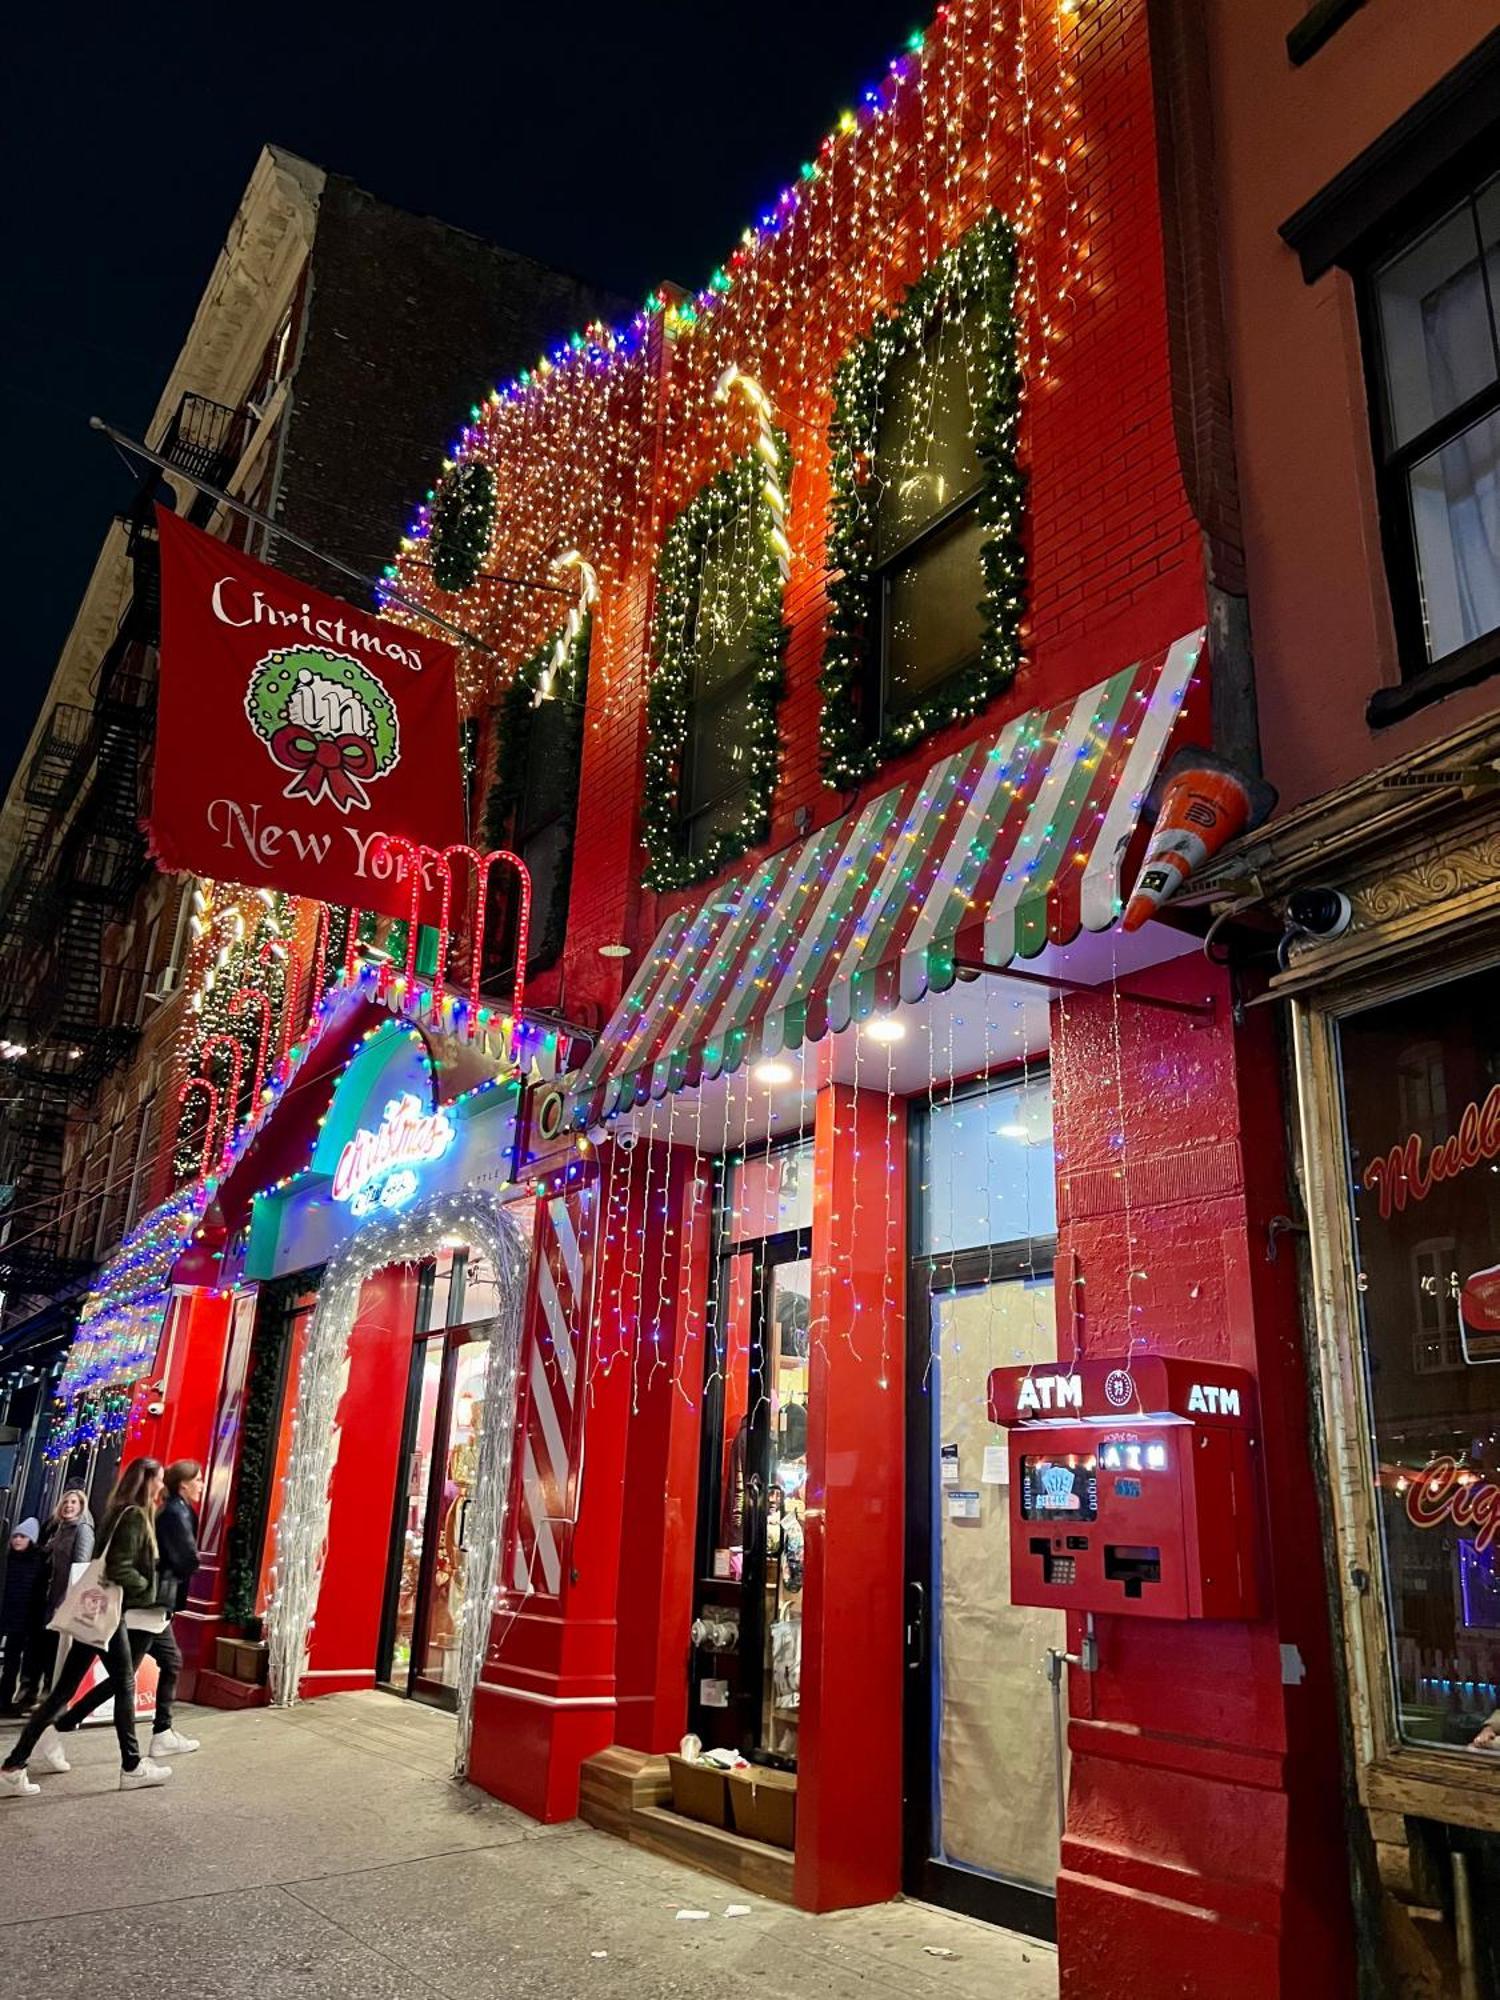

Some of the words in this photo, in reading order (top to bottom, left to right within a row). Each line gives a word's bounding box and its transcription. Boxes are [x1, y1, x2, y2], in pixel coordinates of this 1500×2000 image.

[212, 577, 422, 670] Christmas
[298, 669, 374, 736] in
[208, 800, 331, 868] New
[343, 827, 434, 891] York
[1017, 1375, 1083, 1410] ATM
[1188, 1384, 1240, 1416] ATM
